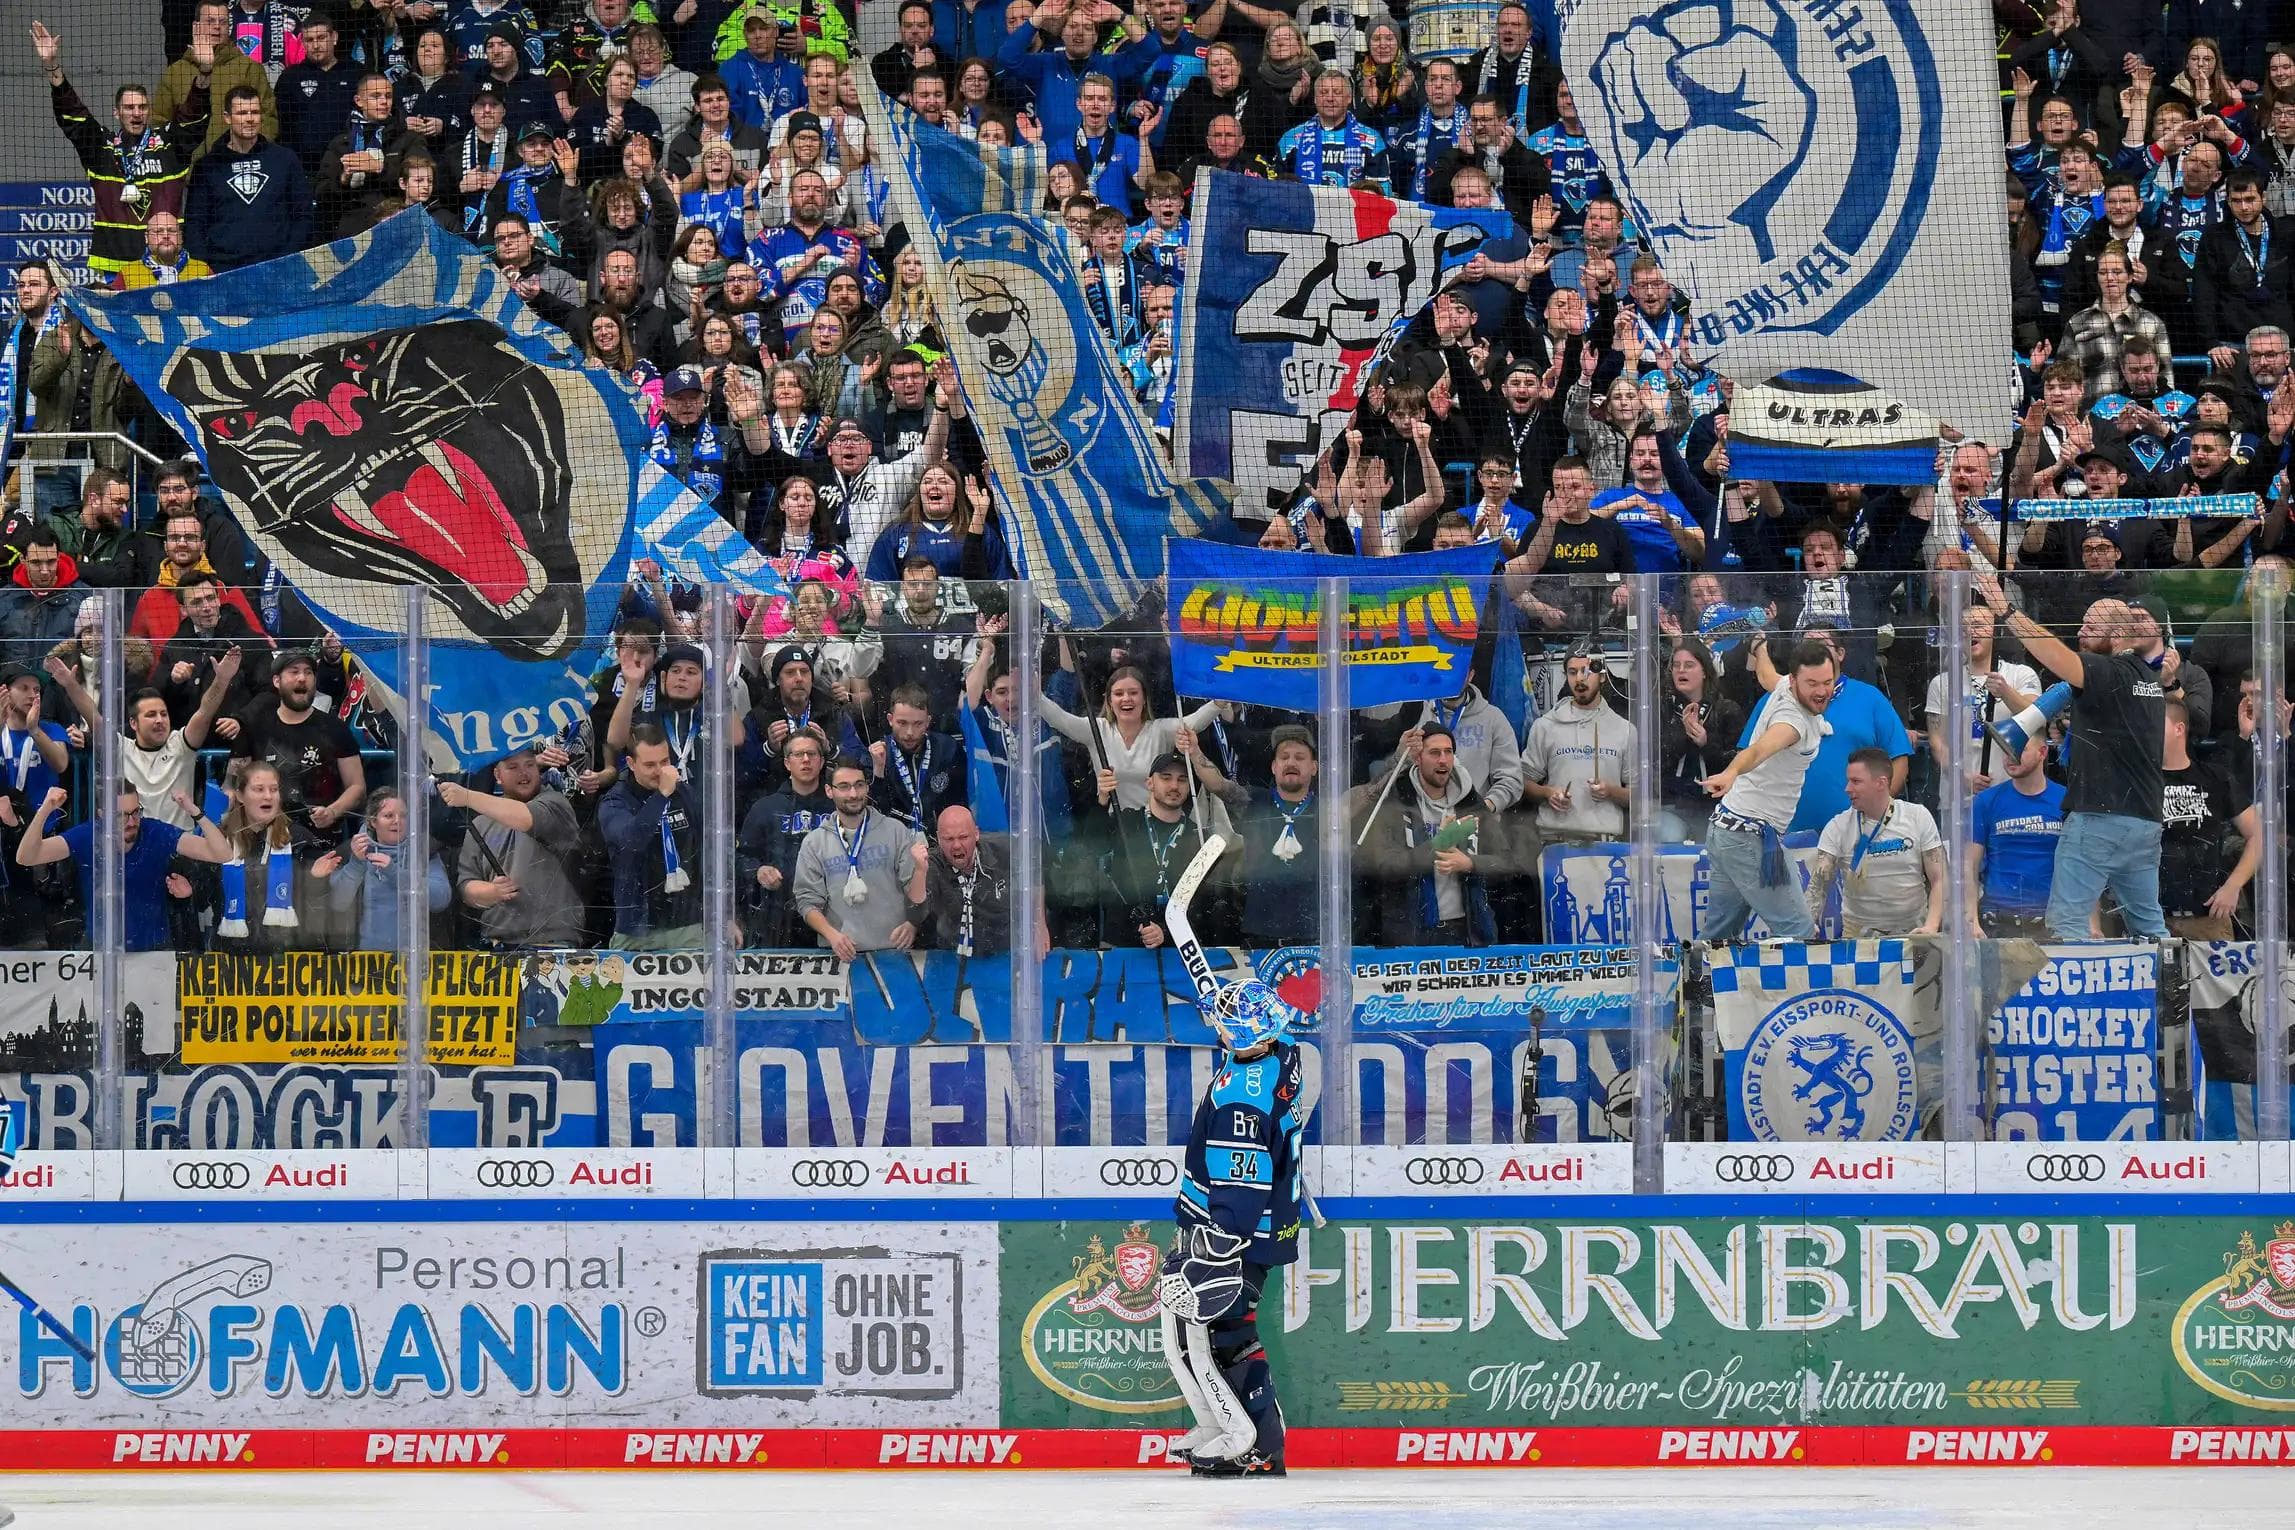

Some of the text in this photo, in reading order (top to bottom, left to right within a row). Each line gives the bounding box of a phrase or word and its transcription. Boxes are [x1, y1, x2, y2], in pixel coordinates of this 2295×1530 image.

[1286, 359, 1345, 397] SEIT
[1767, 401, 1904, 429] ULTRAS
[933, 635, 963, 660] 64
[1253, 655, 1312, 667] ULTRAS
[57, 953, 95, 982] 64
[1357, 964, 1380, 979] ES
[1385, 963, 1412, 977] IST
[1419, 960, 1442, 975] AN
[1447, 958, 1481, 972] DER
[1485, 955, 1524, 970] ZEIT
[1529, 951, 1573, 968] LAUT
[1578, 949, 1601, 965] ZU
[1382, 980, 1412, 993] WIR
[1417, 975, 1500, 992] SCHREIEN
[1504, 973, 1527, 985] ES
[1532, 969, 1584, 984] IMMER
[632, 986, 840, 1011] INGOSTADT
[1362, 995, 1445, 1025] Freiheit
[1437, 996, 1479, 1028] für
[1481, 995, 1513, 1015] die
[184, 997, 238, 1042] FÜR
[1771, 1000, 1861, 1038] EISSPORT-
[1866, 1013, 1898, 1048] UND
[290, 1047, 317, 1057] wer
[320, 1044, 367, 1057] nichts
[371, 1048, 390, 1057] zu
[468, 1045, 497, 1058] hat
[1976, 1053, 2157, 1106] EISTER
[1, 1165, 53, 1188] udi
[264, 1165, 348, 1187] Audi
[569, 1162, 652, 1185] Audi
[884, 1162, 968, 1184] Audi
[1230, 1152, 1258, 1180] 34
[1499, 1158, 1583, 1181] Audi
[1810, 1157, 1894, 1180] Audi
[2121, 1156, 2206, 1179] Audi
[377, 1247, 624, 1289] Personal
[1284, 1221, 2137, 1341] HERRNBRÄU
[724, 1273, 934, 1319] KEIN OHNE
[1076, 1285, 1117, 1312] PREMIUM
[2228, 1280, 2268, 1308] PREMIUM
[19, 1301, 629, 1400] HOFMANN
[724, 1322, 944, 1377] FAN JOB.
[1205, 1370, 1232, 1422] VAPOR
